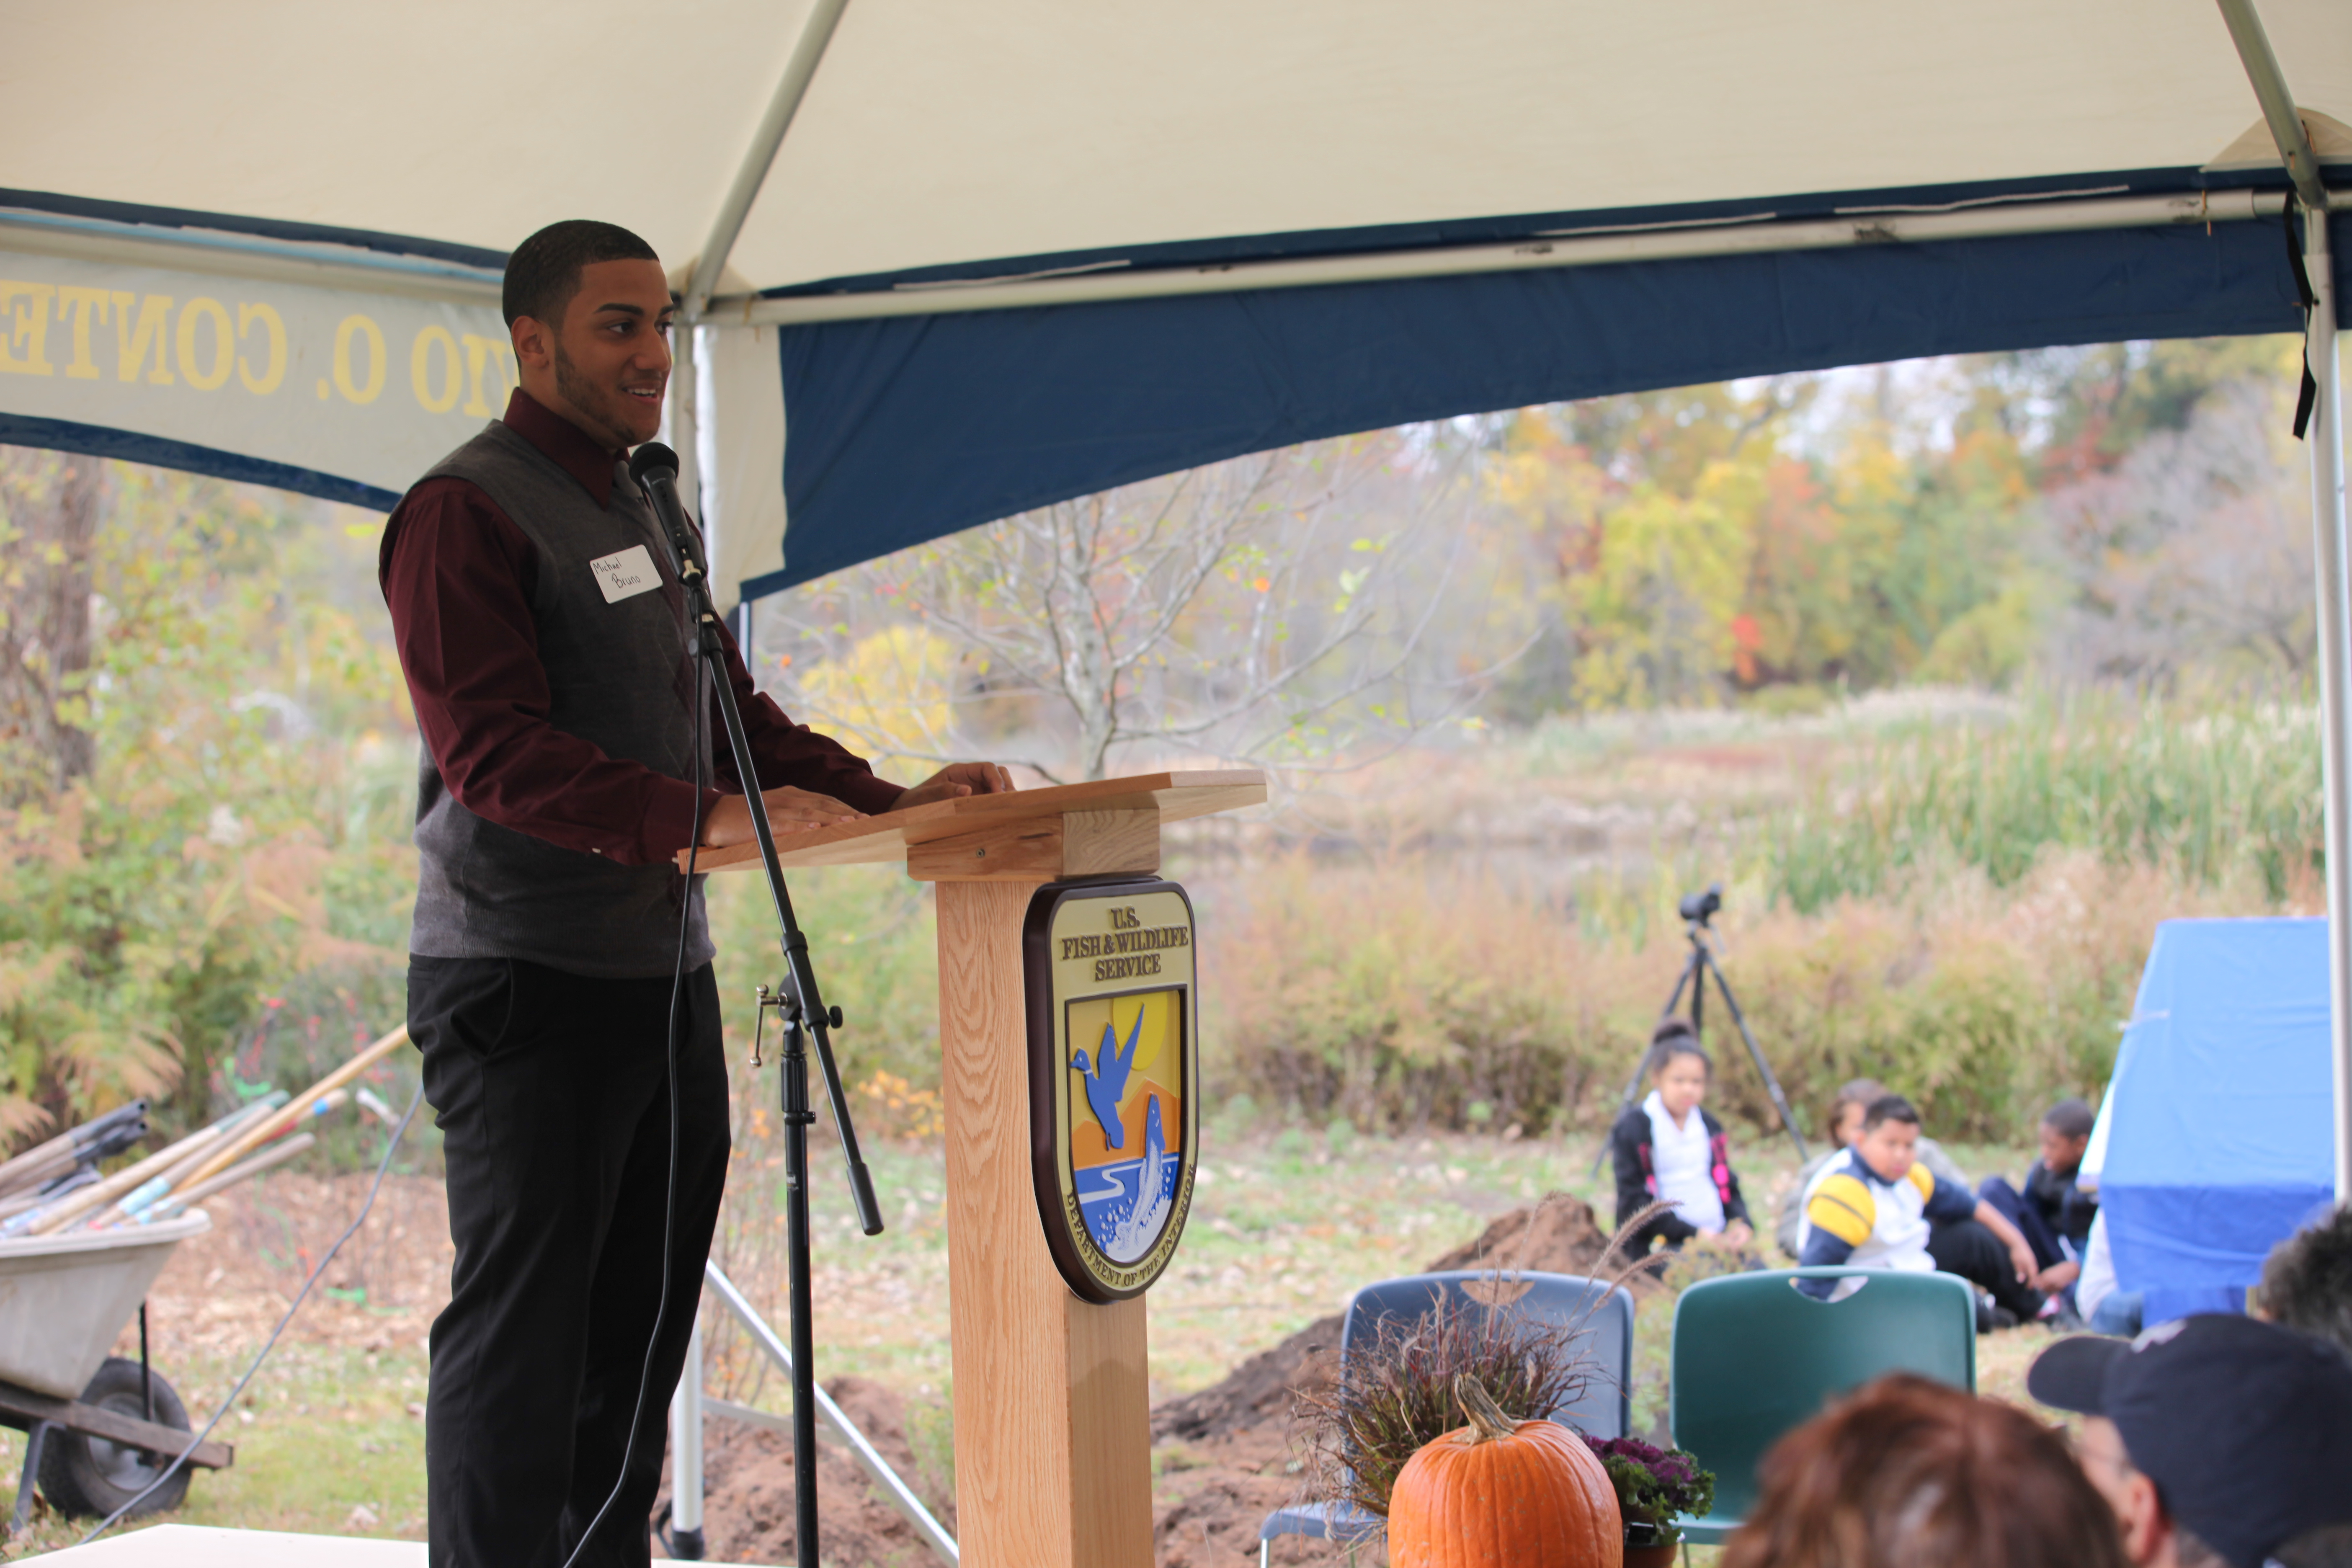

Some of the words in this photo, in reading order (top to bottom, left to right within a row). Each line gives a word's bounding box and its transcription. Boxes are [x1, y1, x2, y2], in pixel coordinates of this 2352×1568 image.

[593, 556, 622, 575] Michael
[611, 573, 641, 589] Bruno
[1111, 905, 1140, 929] U.S.
[1062, 934, 1101, 960] FISH
[1104, 933, 1115, 955] &
[1115, 925, 1189, 952] WILDLIFE
[1095, 952, 1161, 981] SERVICE
[1067, 1189, 1122, 1284] DEPARTMENT
[1123, 1273, 1137, 1287] OF
[1140, 1256, 1161, 1280] THE
[1161, 1163, 1195, 1254] INTERIOR
